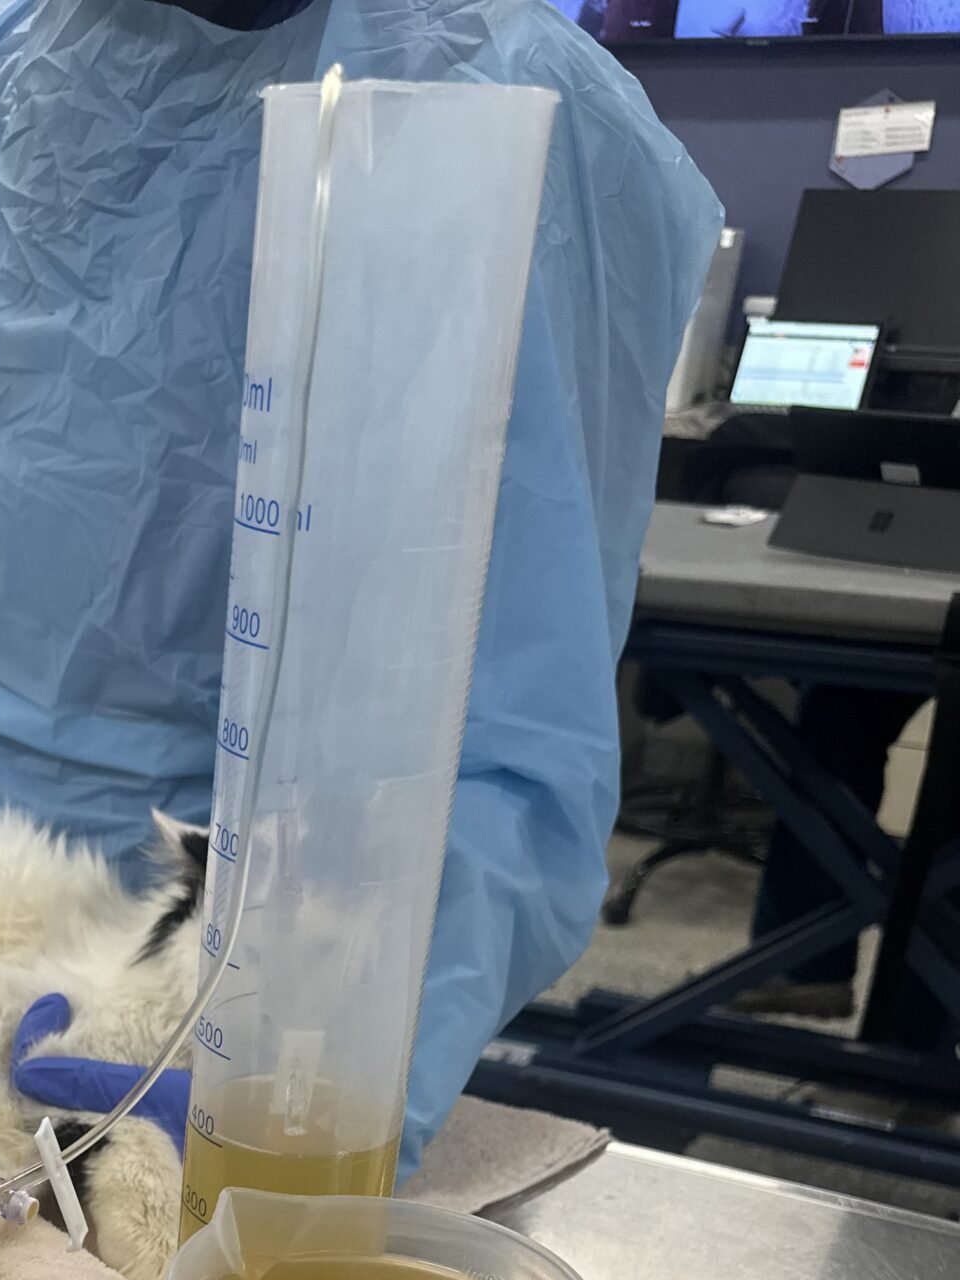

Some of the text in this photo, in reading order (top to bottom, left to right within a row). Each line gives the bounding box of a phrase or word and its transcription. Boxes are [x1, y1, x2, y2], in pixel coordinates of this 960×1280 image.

[241, 493, 279, 527] 1000
[233, 605, 260, 638] 900
[223, 718, 248, 751] 800
[215, 822, 239, 857] 700
[207, 923, 221, 951] 60
[199, 1016, 223, 1048] 500
[192, 1104, 214, 1135] 400
[186, 1184, 207, 1217] 300
